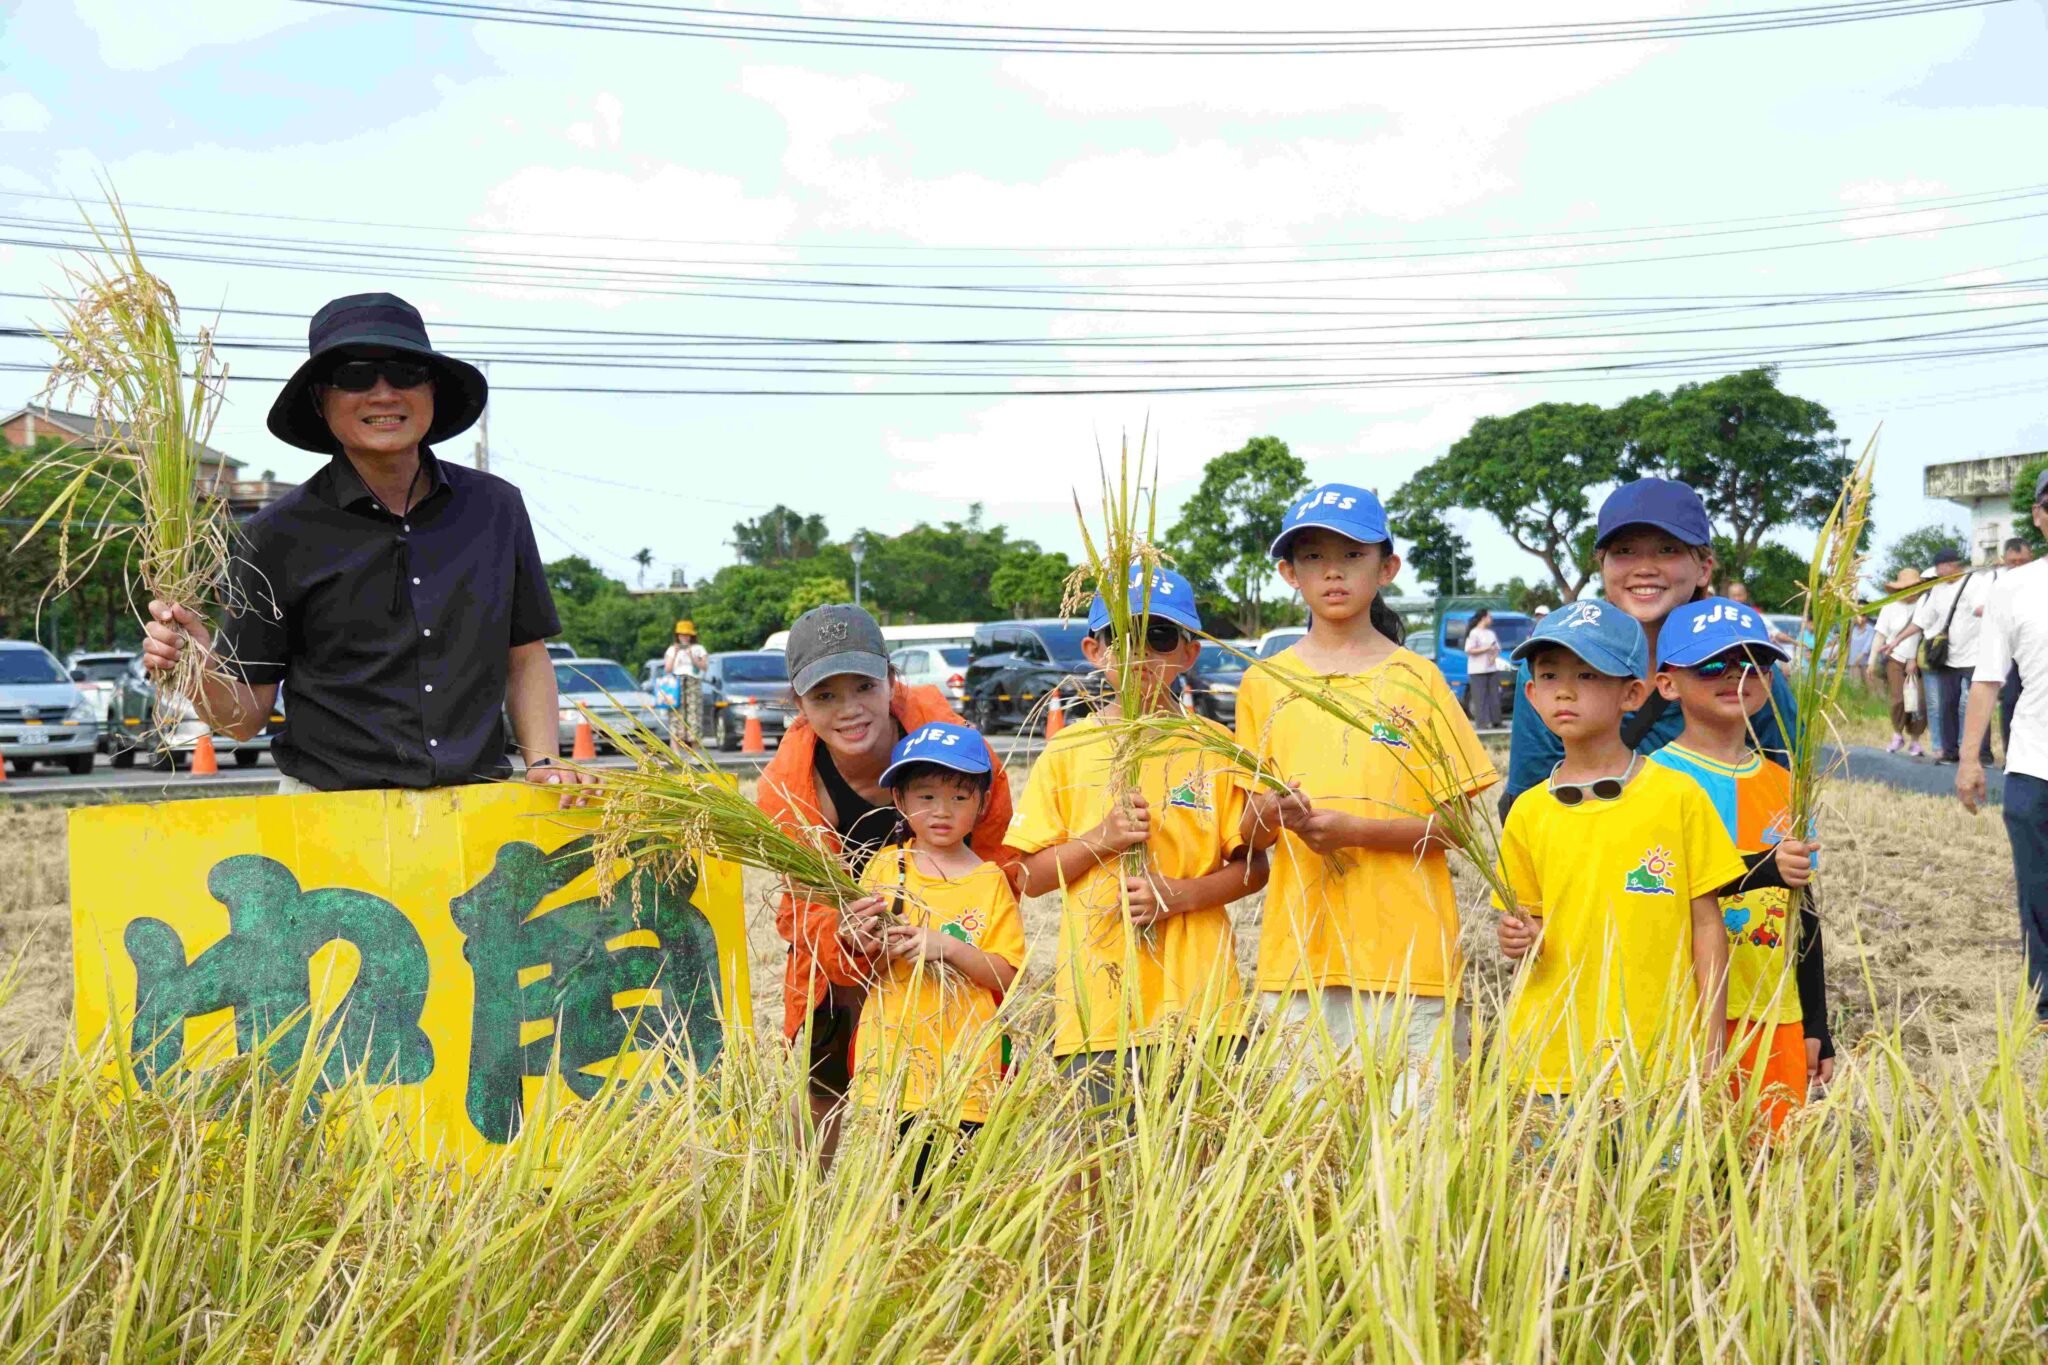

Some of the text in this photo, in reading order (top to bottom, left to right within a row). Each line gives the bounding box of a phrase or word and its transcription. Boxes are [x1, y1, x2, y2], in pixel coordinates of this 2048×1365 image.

[1296, 491, 1357, 520] ZJES
[1126, 572, 1175, 595] JES
[1692, 604, 1753, 633] ZJES
[902, 728, 960, 756] ZJES
